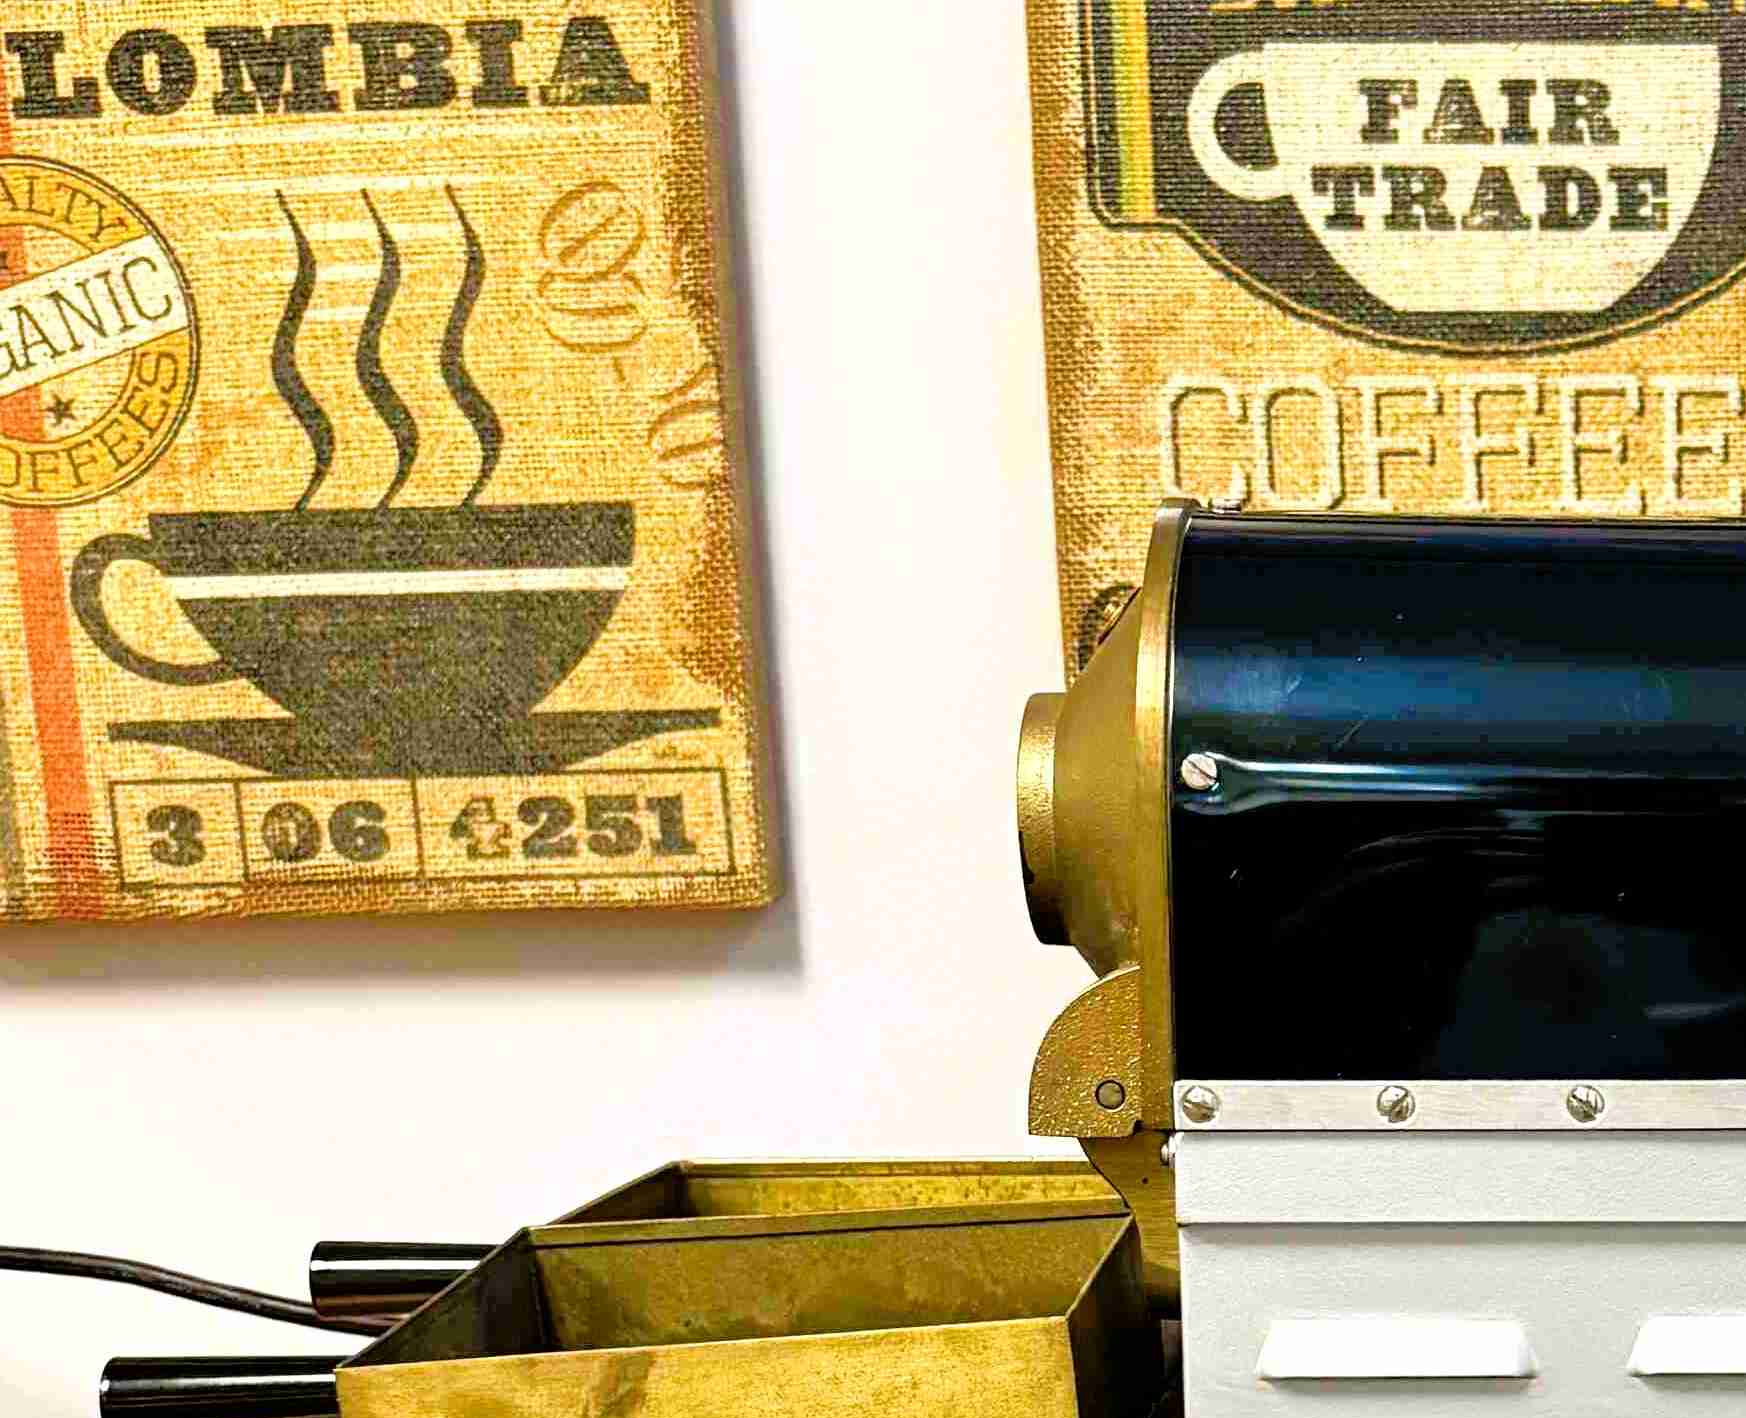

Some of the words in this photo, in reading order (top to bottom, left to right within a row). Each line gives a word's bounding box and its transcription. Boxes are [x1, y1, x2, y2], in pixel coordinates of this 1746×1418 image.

[4, 16, 653, 119] LOMBIA
[1359, 78, 1621, 146] FAIR
[1311, 166, 1669, 233] TRADE
[146, 804, 205, 867] 3
[262, 800, 391, 863] 06
[449, 792, 697, 860] 4251
